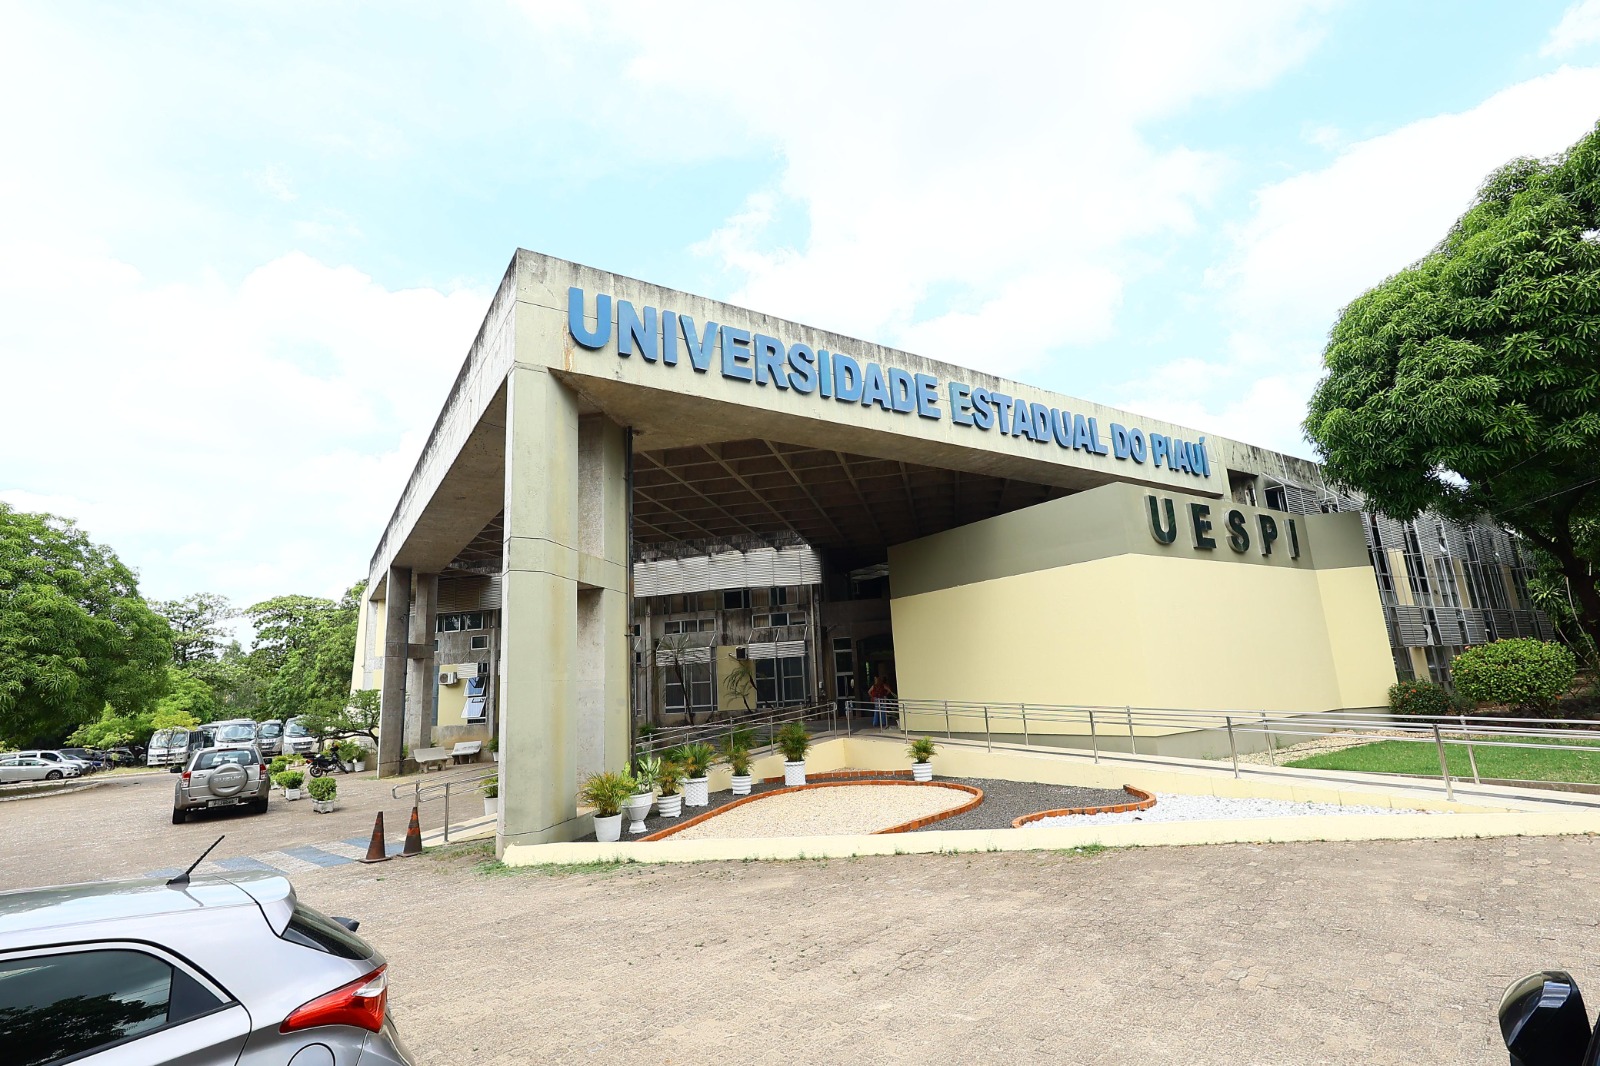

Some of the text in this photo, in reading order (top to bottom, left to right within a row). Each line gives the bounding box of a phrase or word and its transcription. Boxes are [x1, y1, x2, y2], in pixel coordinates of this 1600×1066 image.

[568, 286, 1212, 478] UNIVERSIDADE ESTADUAL DO PIAUÍ
[1144, 494, 1300, 560] UESPI
